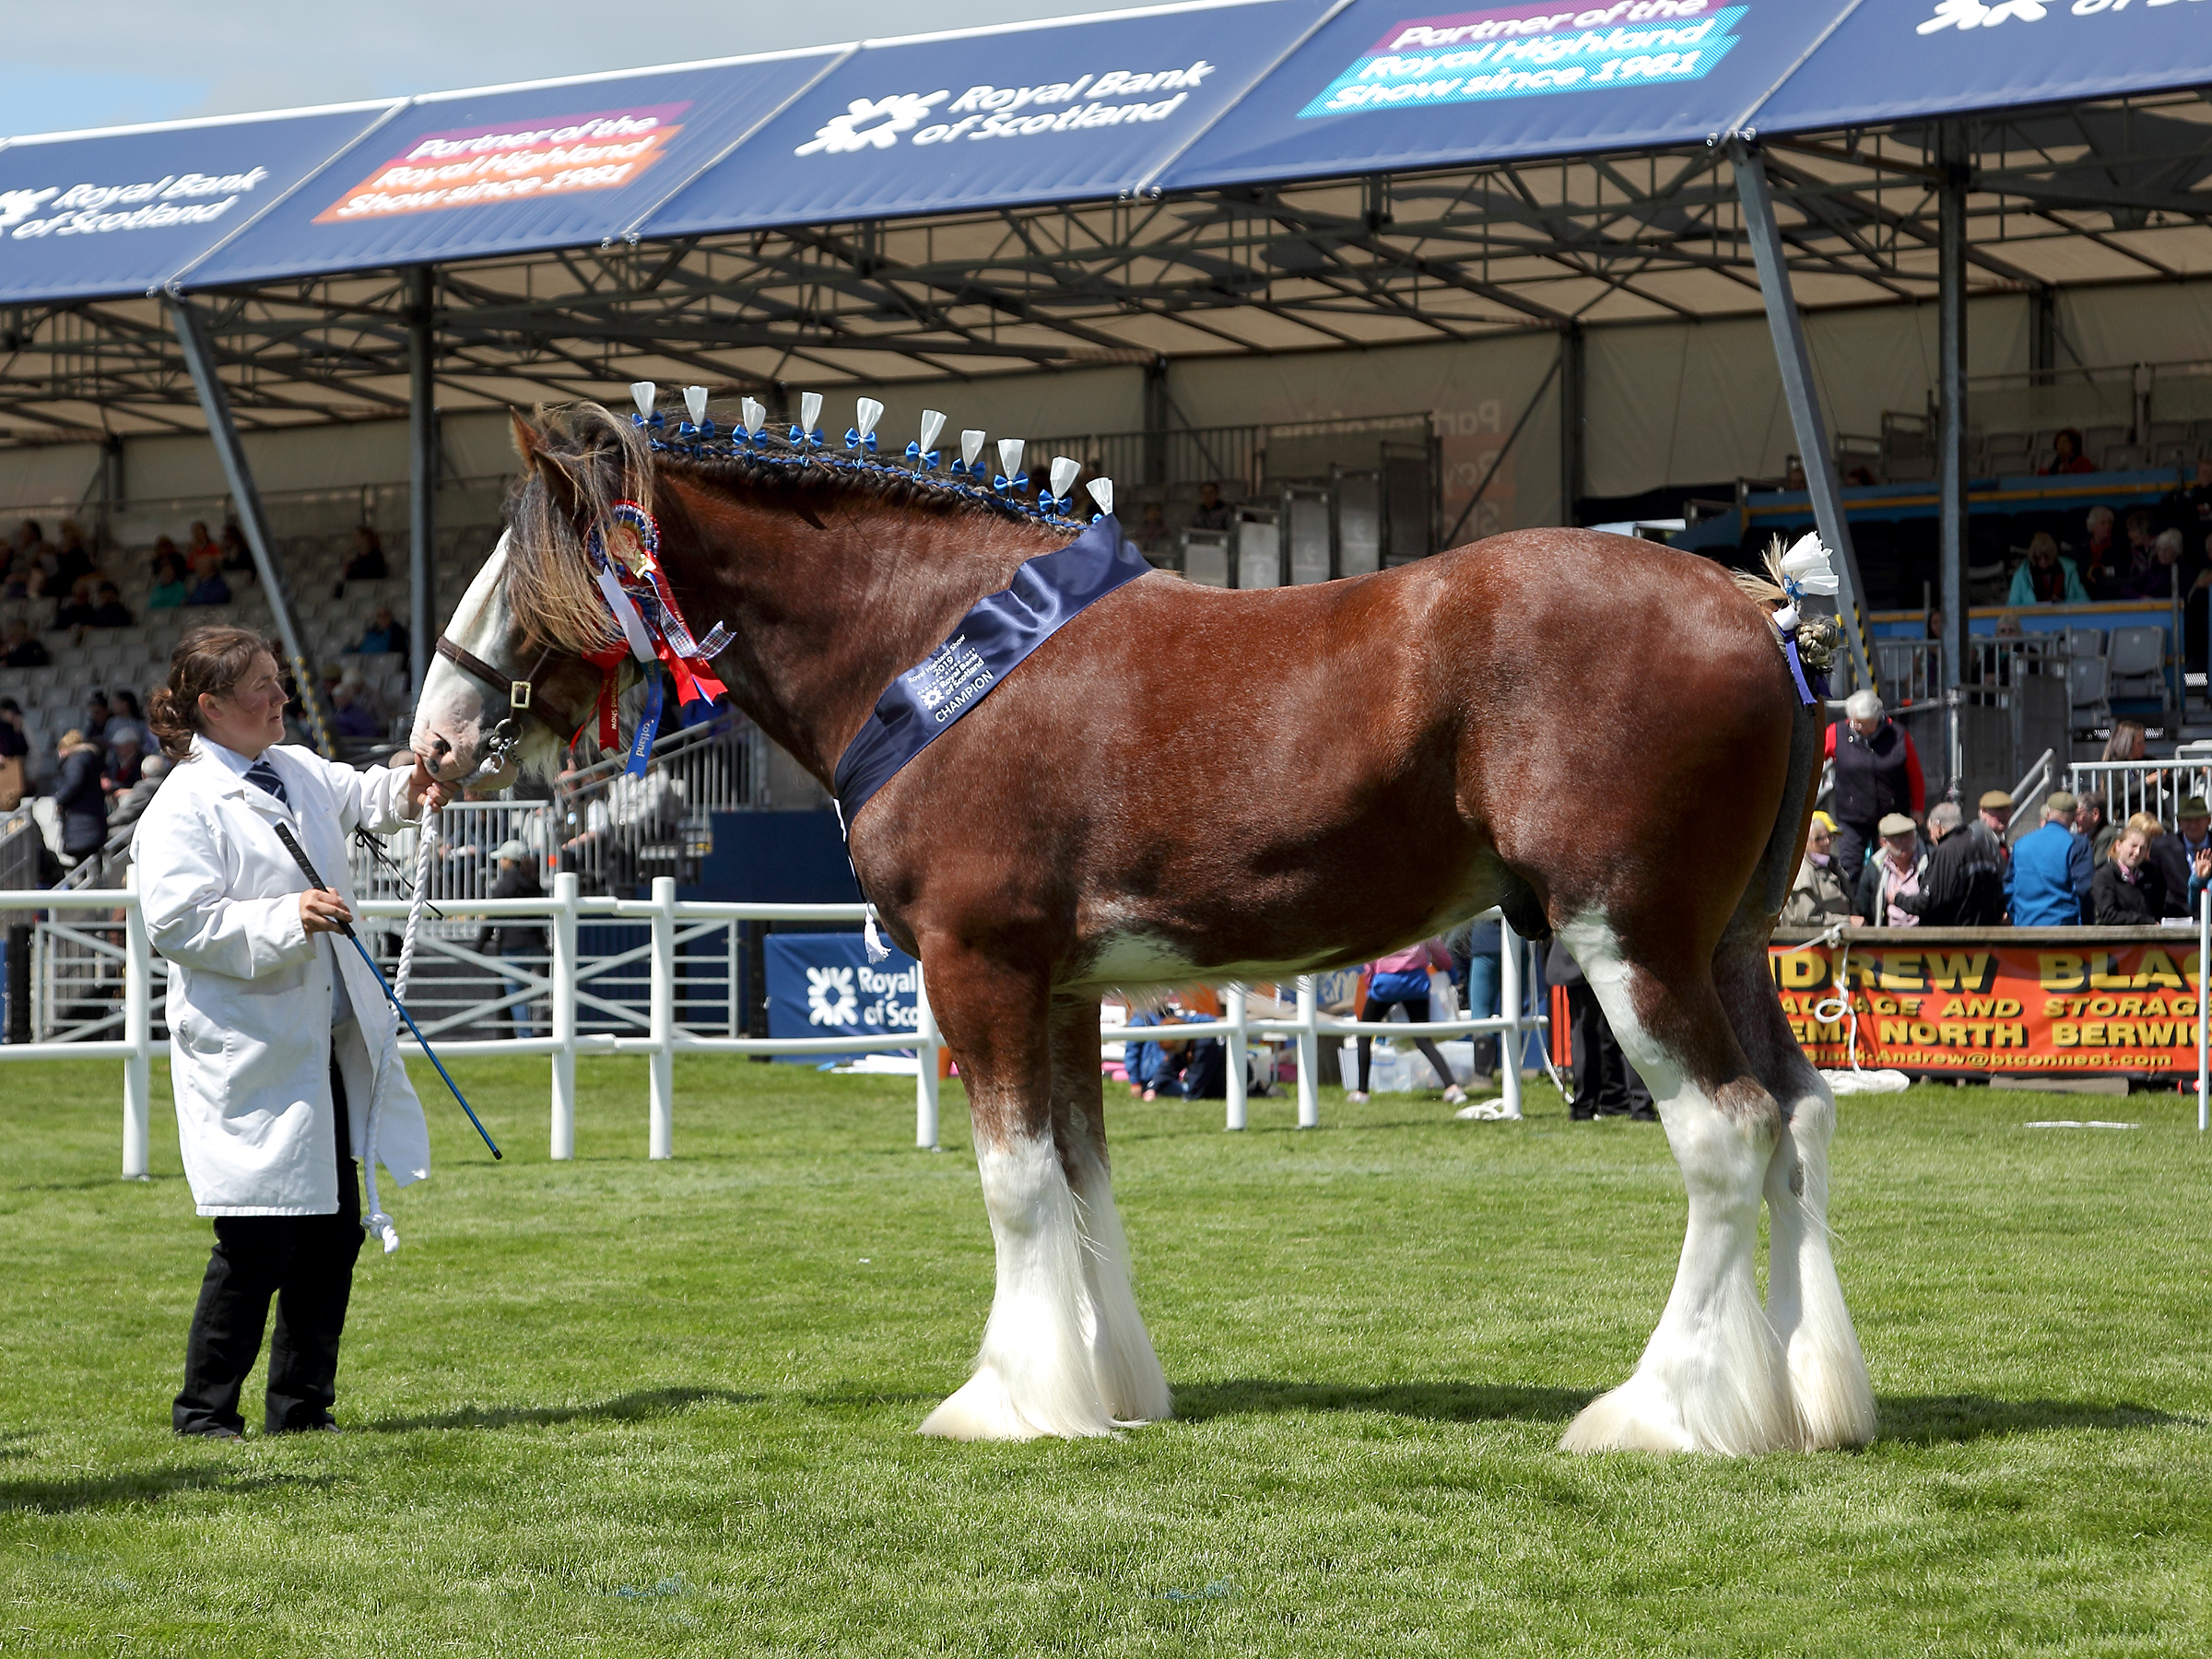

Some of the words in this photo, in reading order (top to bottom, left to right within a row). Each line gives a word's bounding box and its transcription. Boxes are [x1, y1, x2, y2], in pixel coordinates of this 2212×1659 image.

[1358, 38, 1494, 79] Royal
[1492, 18, 1716, 63] Highland
[1389, 12, 1574, 51] Partner
[1571, 0, 1636, 29] of
[947, 73, 1094, 114] Royal
[1083, 59, 1216, 100] Bank
[1325, 76, 1454, 109] Show
[1462, 67, 1587, 94] since
[1589, 50, 1702, 83] 1981
[406, 127, 555, 161] Partner
[549, 118, 597, 144] of
[590, 114, 660, 135] the
[912, 114, 984, 146] of
[967, 91, 1189, 141] Scotland
[371, 154, 480, 188] Royal
[483, 135, 657, 174] Highland
[50, 174, 176, 211] Royal
[159, 165, 269, 201] Bank
[336, 190, 449, 217] Show
[442, 176, 544, 203] since
[542, 162, 636, 189] 1981
[11, 210, 77, 240] of
[55, 194, 241, 236] Scotland
[907, 669, 926, 684] Royal
[924, 648, 951, 673] Highland
[949, 633, 966, 652] Show
[933, 655, 954, 677] 2019
[939, 667, 961, 689] Royal
[959, 653, 980, 672] Bank
[945, 683, 955, 696] of
[953, 656, 985, 688] Scotland
[934, 669, 994, 723] CHAMPION
[610, 709, 619, 730] Show
[635, 719, 654, 758] Scotland
[857, 965, 916, 1001] Royal
[1770, 952, 1991, 989] DREW
[864, 999, 885, 1026] of
[1940, 997, 2021, 1018] AND
[2042, 995, 2212, 1018] STORAG
[1879, 1019, 2024, 1047] NORTH
